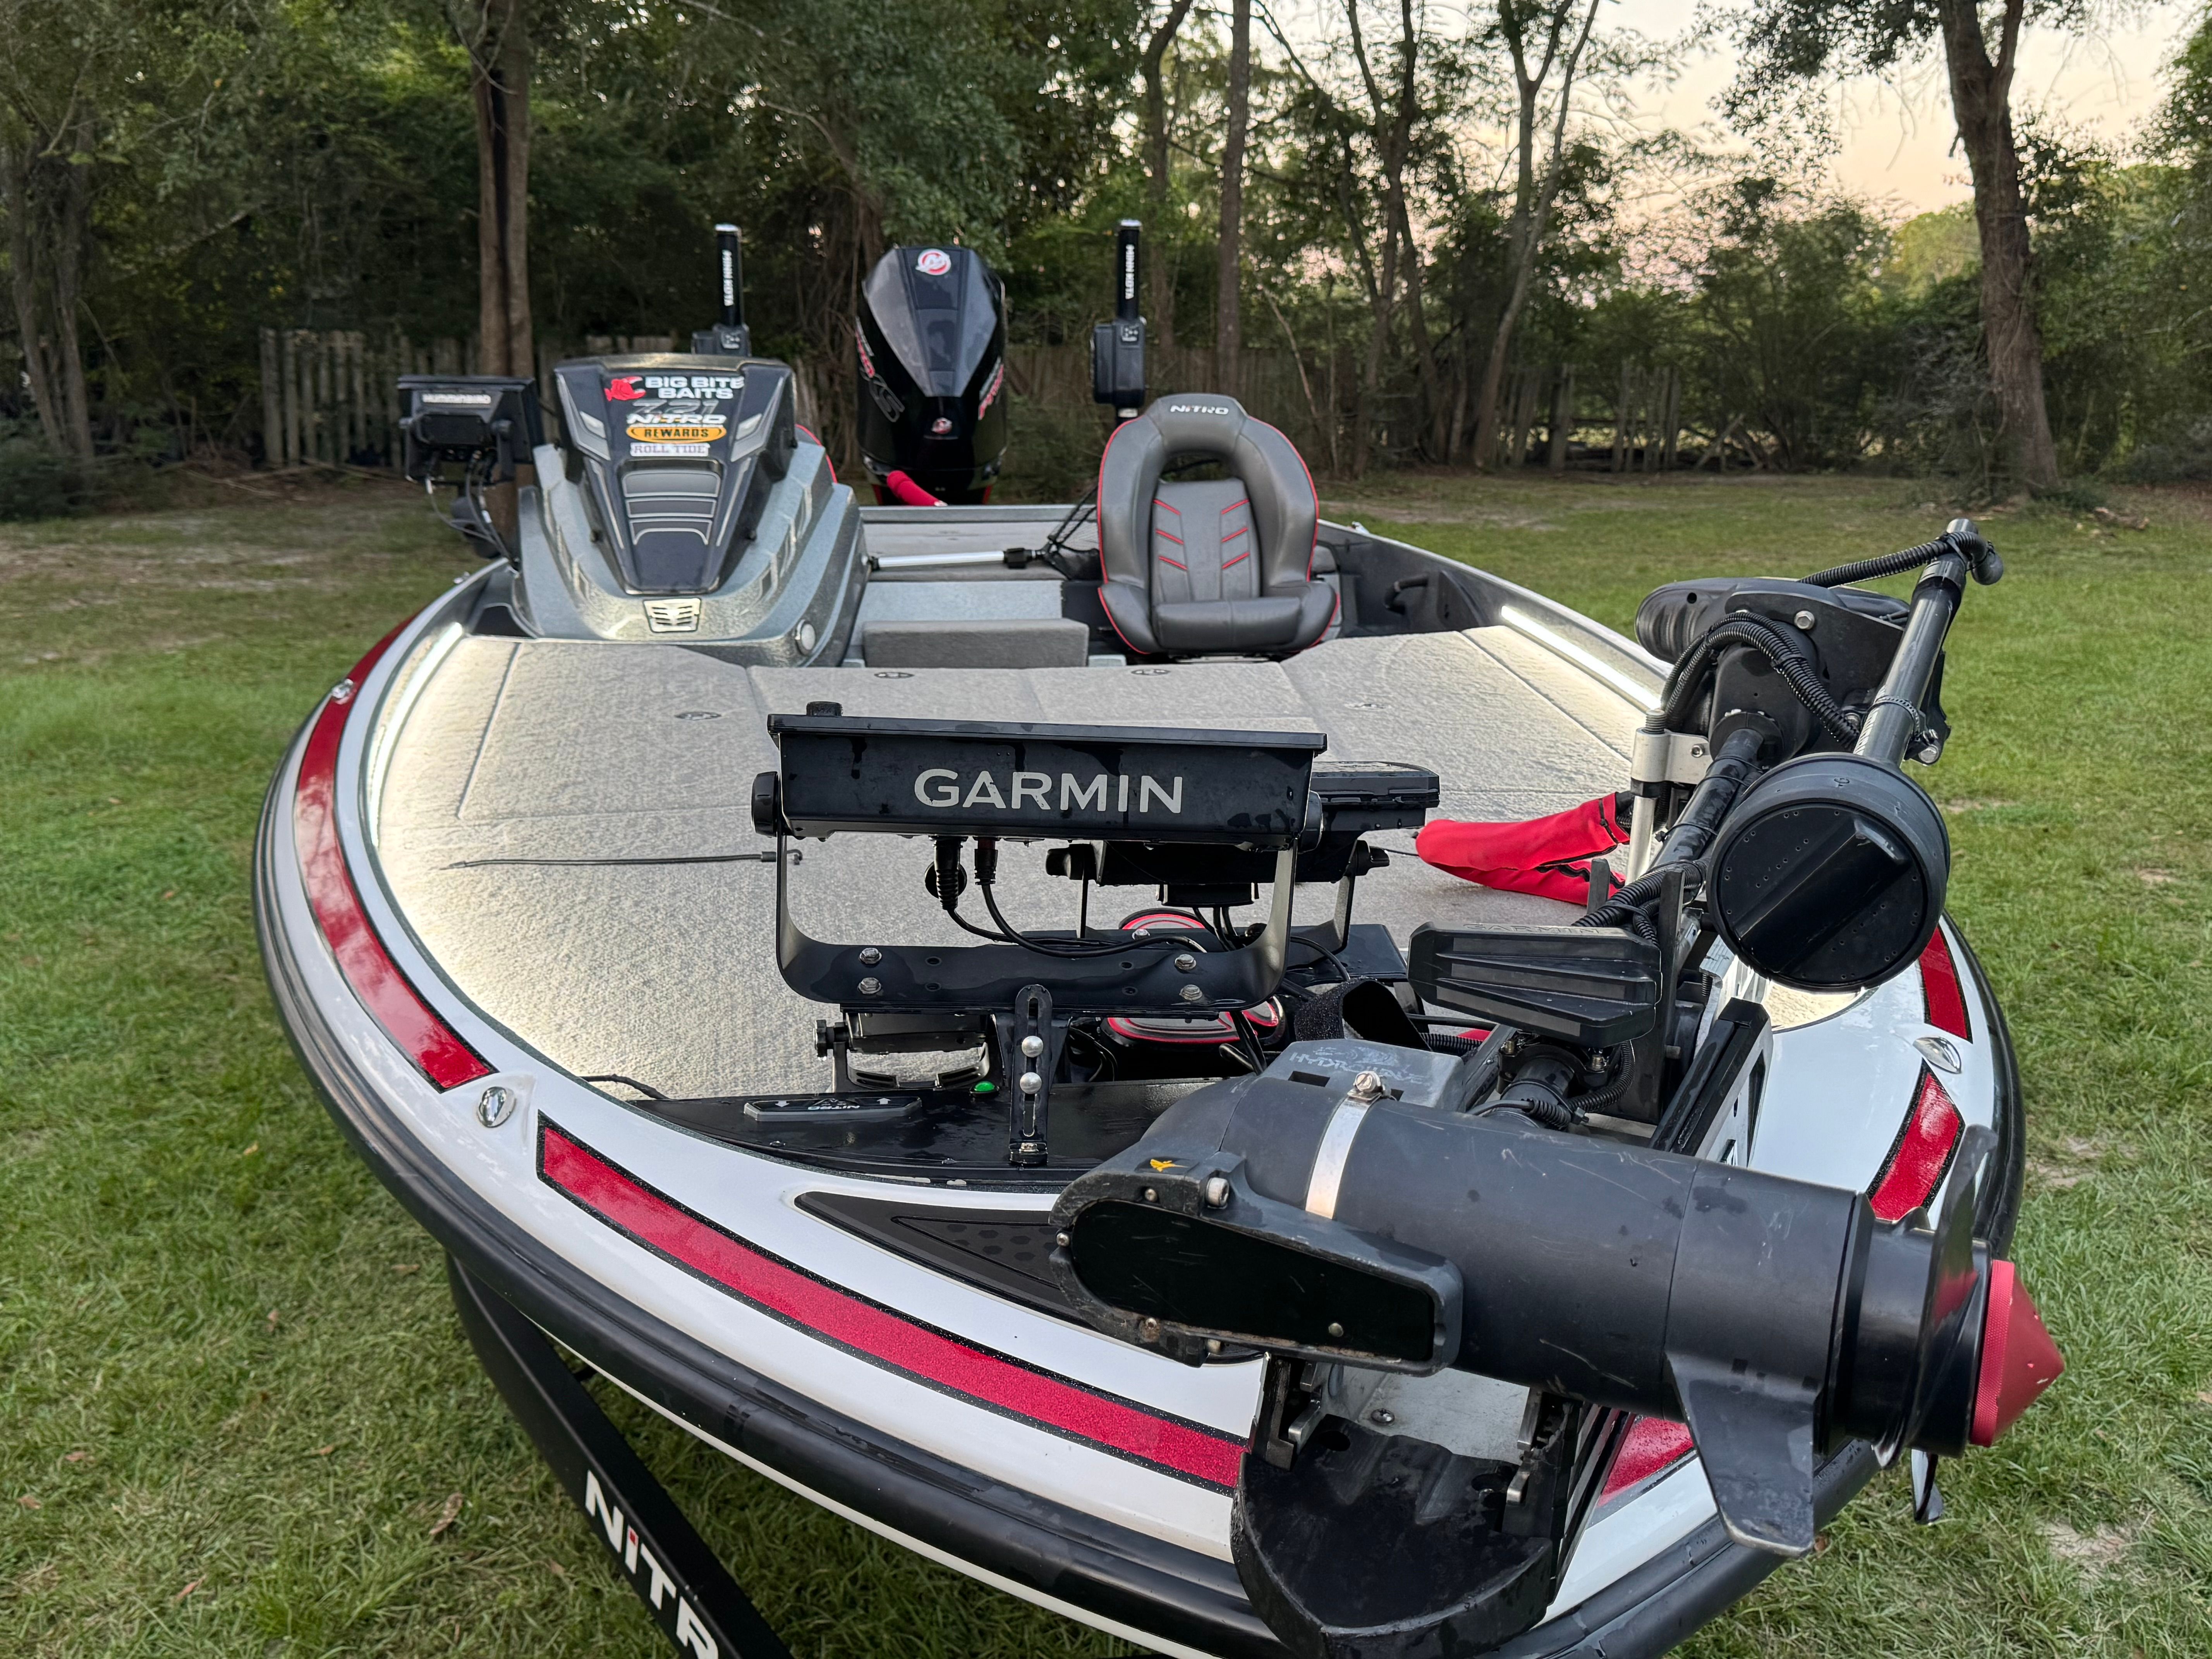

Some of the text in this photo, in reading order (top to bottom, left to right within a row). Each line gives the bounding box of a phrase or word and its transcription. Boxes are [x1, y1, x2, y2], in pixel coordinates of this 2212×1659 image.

[645, 376, 745, 389] BIG BITE
[658, 388, 733, 399] BAITS
[1170, 405, 1229, 415] NITRO
[627, 414, 727, 424] NITRO
[644, 428, 709, 438] REWARDS
[634, 445, 705, 453] ROLL TIDE
[914, 768, 1183, 813] GARMIN
[1463, 923, 1599, 934] GARMIN
